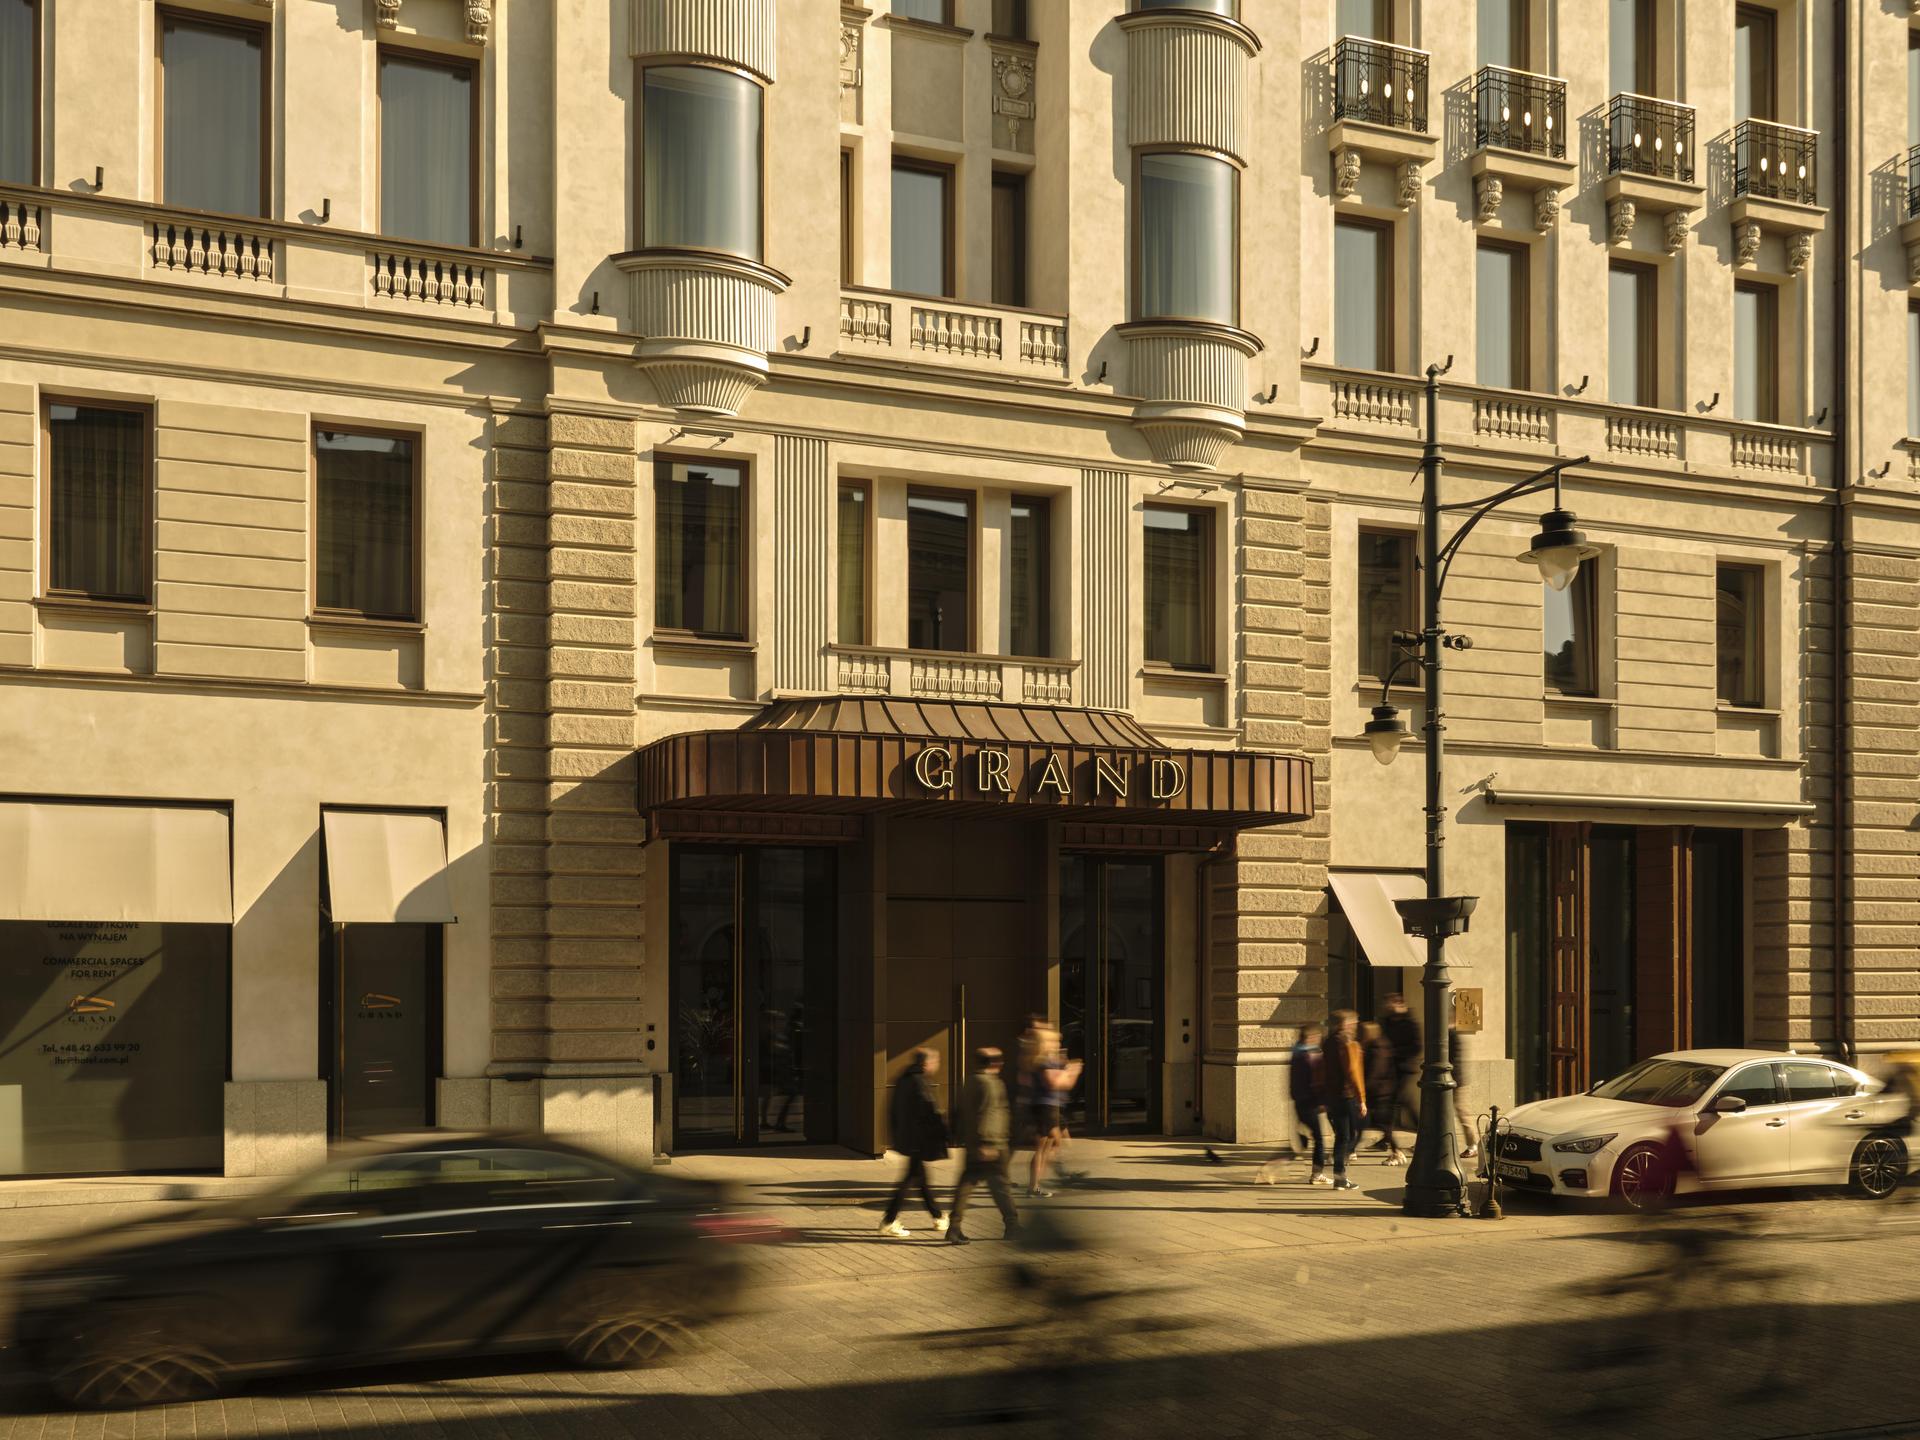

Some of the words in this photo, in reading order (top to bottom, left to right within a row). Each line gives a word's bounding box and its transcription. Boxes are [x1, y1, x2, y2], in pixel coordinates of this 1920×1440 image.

[915, 746, 1187, 799] GRAND
[59, 933, 75, 942] NA
[78, 933, 127, 941] WYNAJEM
[42, 957, 107, 967] COMMERCIAL
[110, 957, 145, 967] SPACES
[71, 969, 91, 978] FOR
[93, 969, 117, 978] RENT
[80, 1044, 92, 1052] 42
[128, 1044, 141, 1052] 20
